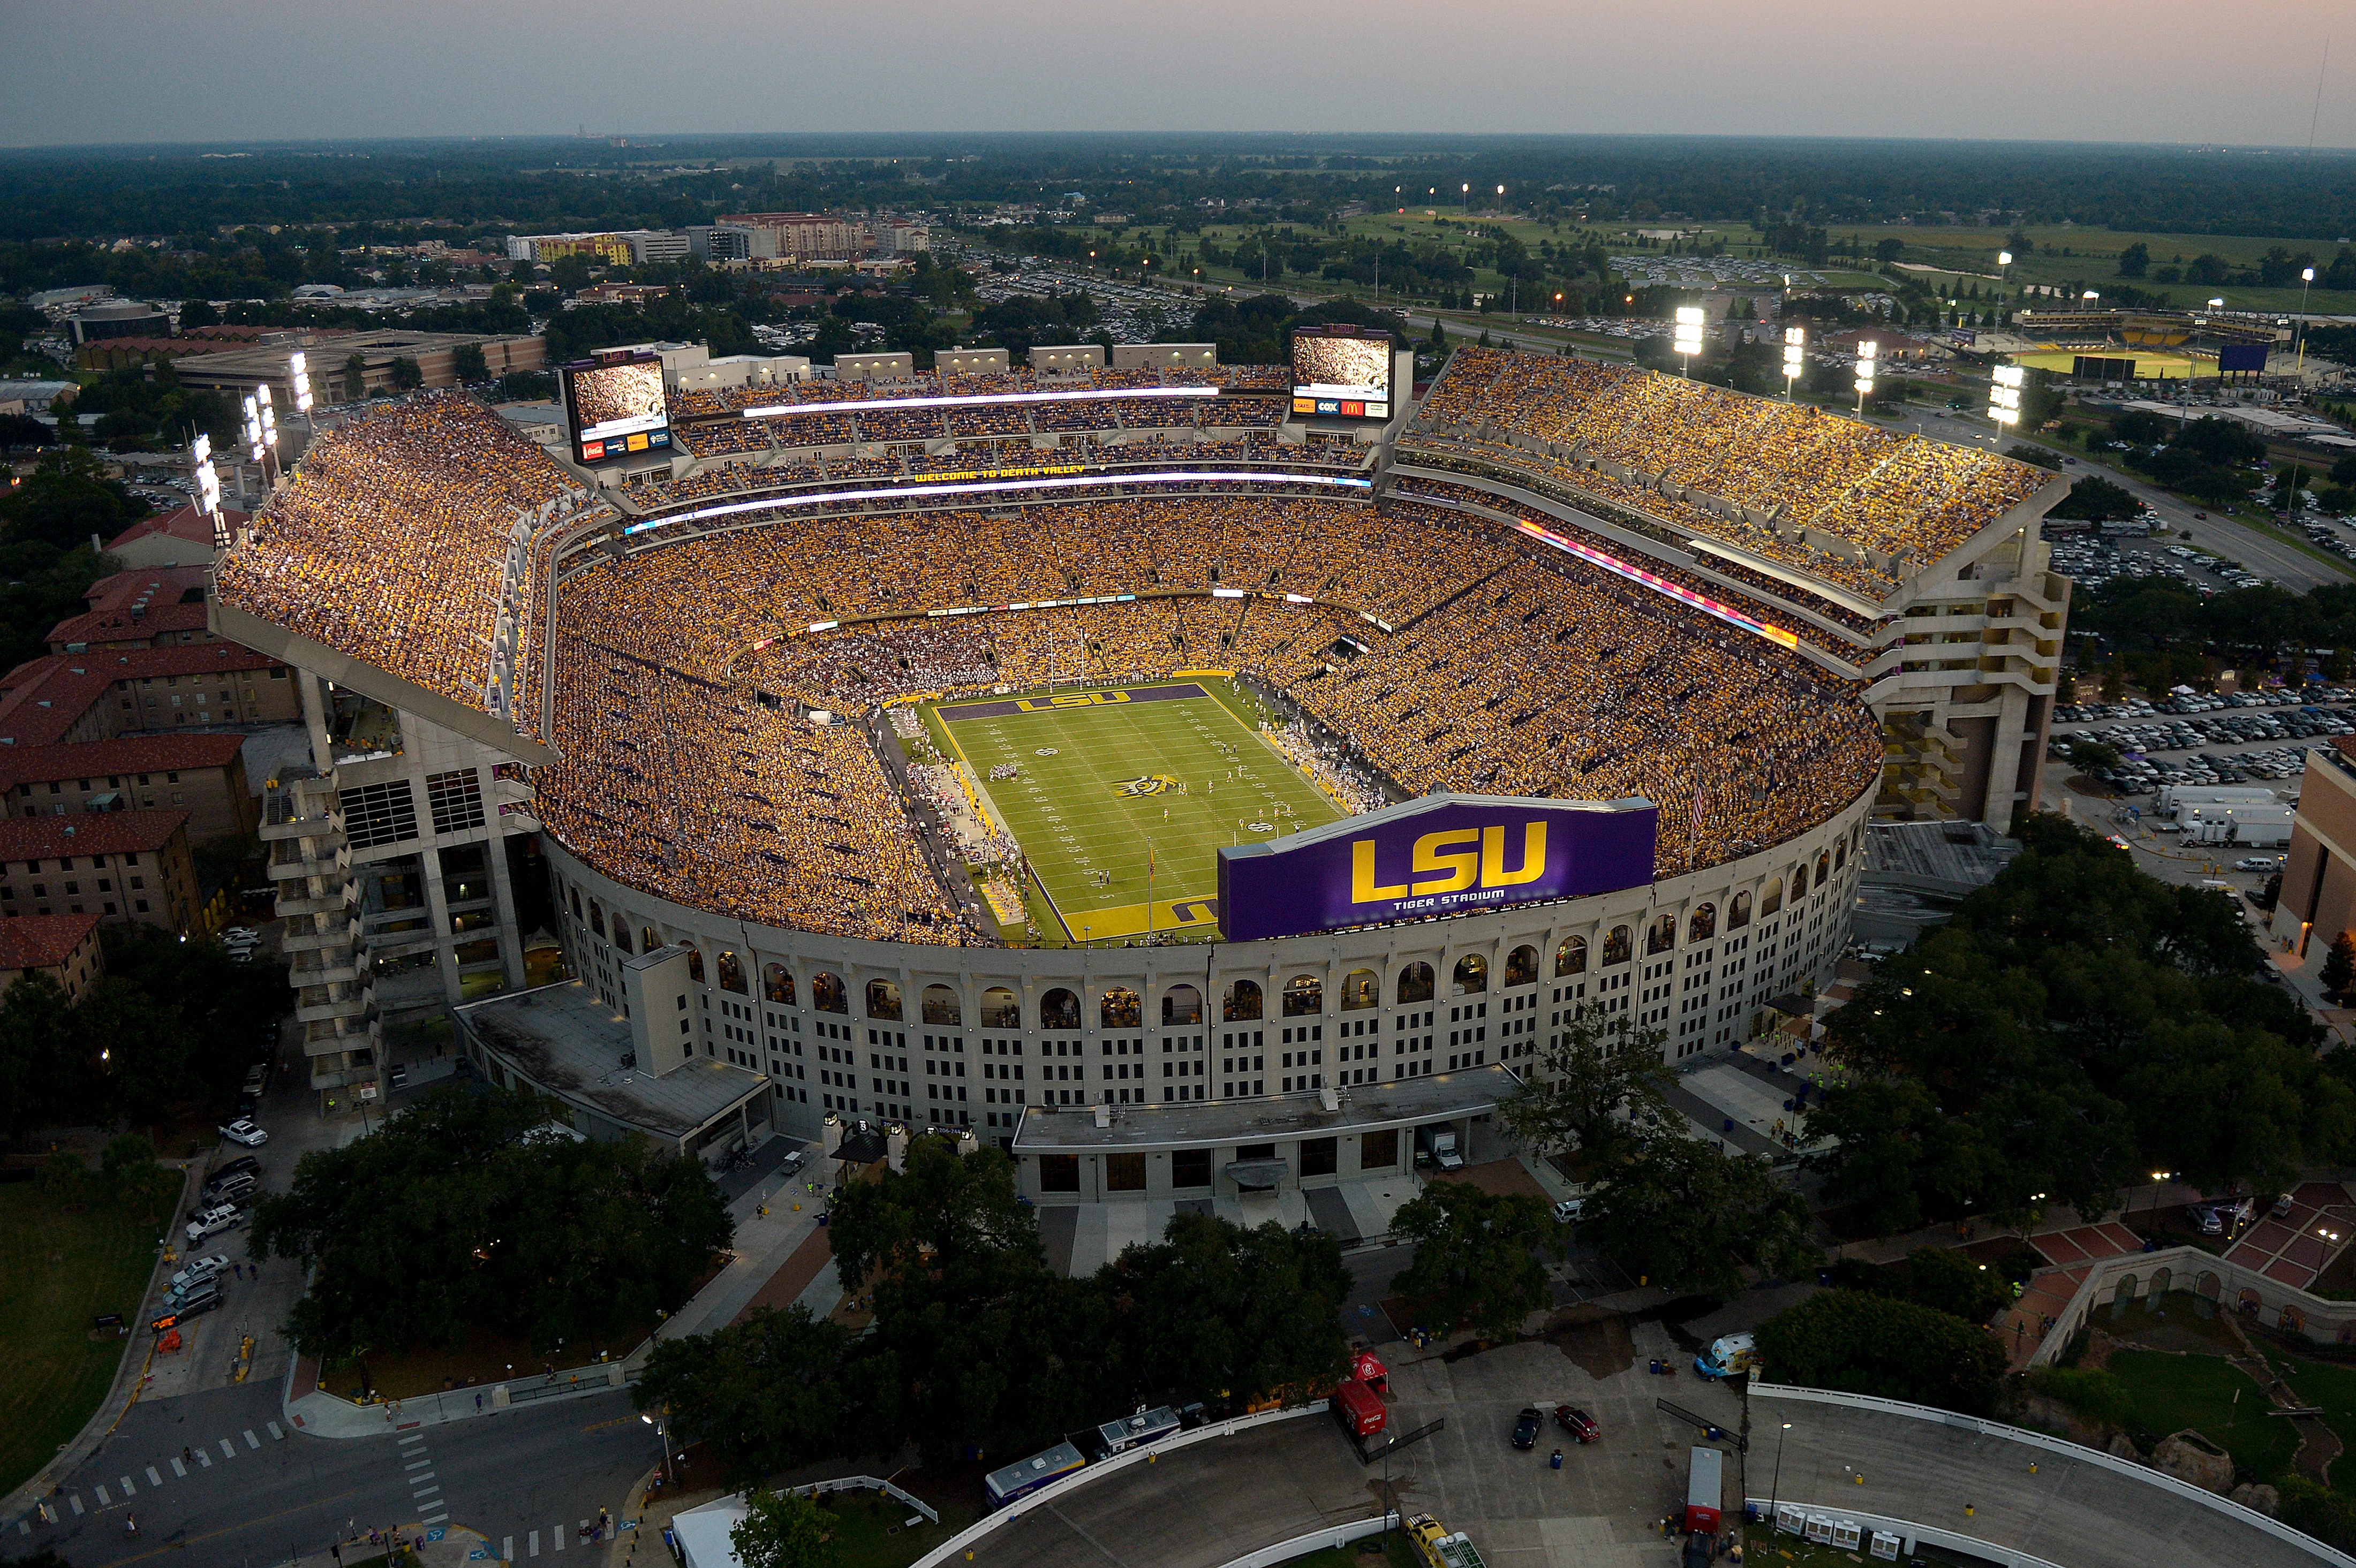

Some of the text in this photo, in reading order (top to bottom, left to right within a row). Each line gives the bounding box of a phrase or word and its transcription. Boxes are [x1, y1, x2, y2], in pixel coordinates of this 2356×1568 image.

[1329, 324, 1355, 334] LSU
[602, 351, 627, 363] LSU
[1318, 403, 1338, 412] COX
[587, 446, 603, 456] Coca-Cola
[915, 465, 1085, 482] WELCOME TO DEATH VALLEY
[1016, 691, 1132, 712] LSU
[1351, 821, 1547, 904] LSU
[1393, 889, 1505, 911] TIGER STADIUM
[1364, 1414, 1381, 1424] Coca-Cola
